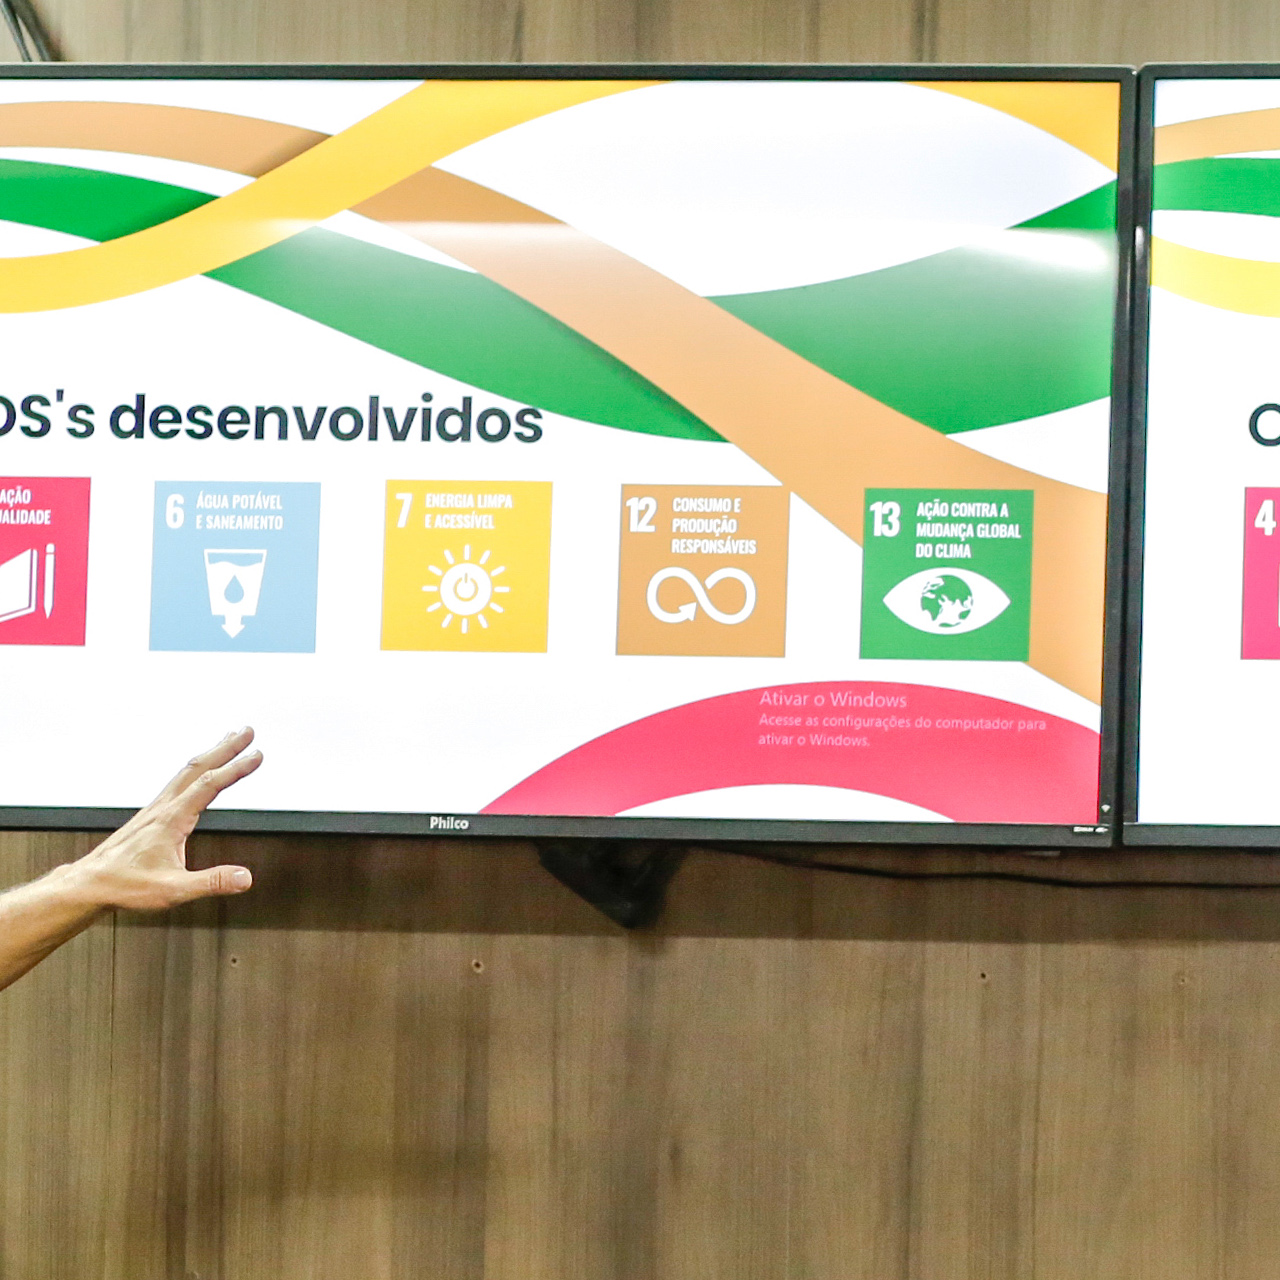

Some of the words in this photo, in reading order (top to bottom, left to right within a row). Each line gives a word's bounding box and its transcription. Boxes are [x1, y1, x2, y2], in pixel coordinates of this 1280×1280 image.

[109, 392, 543, 443] desenvolvidos
[196, 491, 228, 509] ÁGUA
[232, 491, 282, 509] POTÁVEL
[426, 493, 474, 508] ENERGIA
[477, 494, 513, 508] LIMPA
[672, 498, 731, 512] CONSUMO
[734, 498, 741, 512] E
[166, 494, 184, 529] 6
[396, 493, 413, 528] 7
[626, 497, 657, 532] 12
[916, 499, 949, 520] AÇÃO
[951, 502, 998, 517] CONTRA
[1000, 503, 1009, 518] A
[1254, 499, 1277, 536] 4
[196, 515, 202, 529] E
[206, 515, 283, 530] SANEAMENTO
[425, 514, 431, 528] E
[434, 511, 495, 529] ACESSÍVEL
[672, 515, 737, 536] PRODUÇÃO
[870, 501, 901, 537] 13
[916, 523, 974, 541] MUDANÇA
[976, 524, 1022, 538] GLOBAL
[671, 536, 757, 554] RESPONSÁVEIS
[915, 543, 933, 558] DO
[935, 543, 972, 558] CLIMA
[759, 690, 810, 706] Ativar
[814, 694, 825, 707] o
[830, 691, 907, 708] Windows
[758, 713, 802, 727] Acesse
[805, 716, 819, 727] as
[822, 713, 911, 731] configurações
[915, 715, 931, 728] do
[935, 716, 1013, 733] computador
[1018, 719, 1046, 732] para
[758, 733, 793, 746] ativar
[797, 737, 806, 746] o
[809, 733, 870, 747] Windows.
[429, 816, 469, 830] Philco
